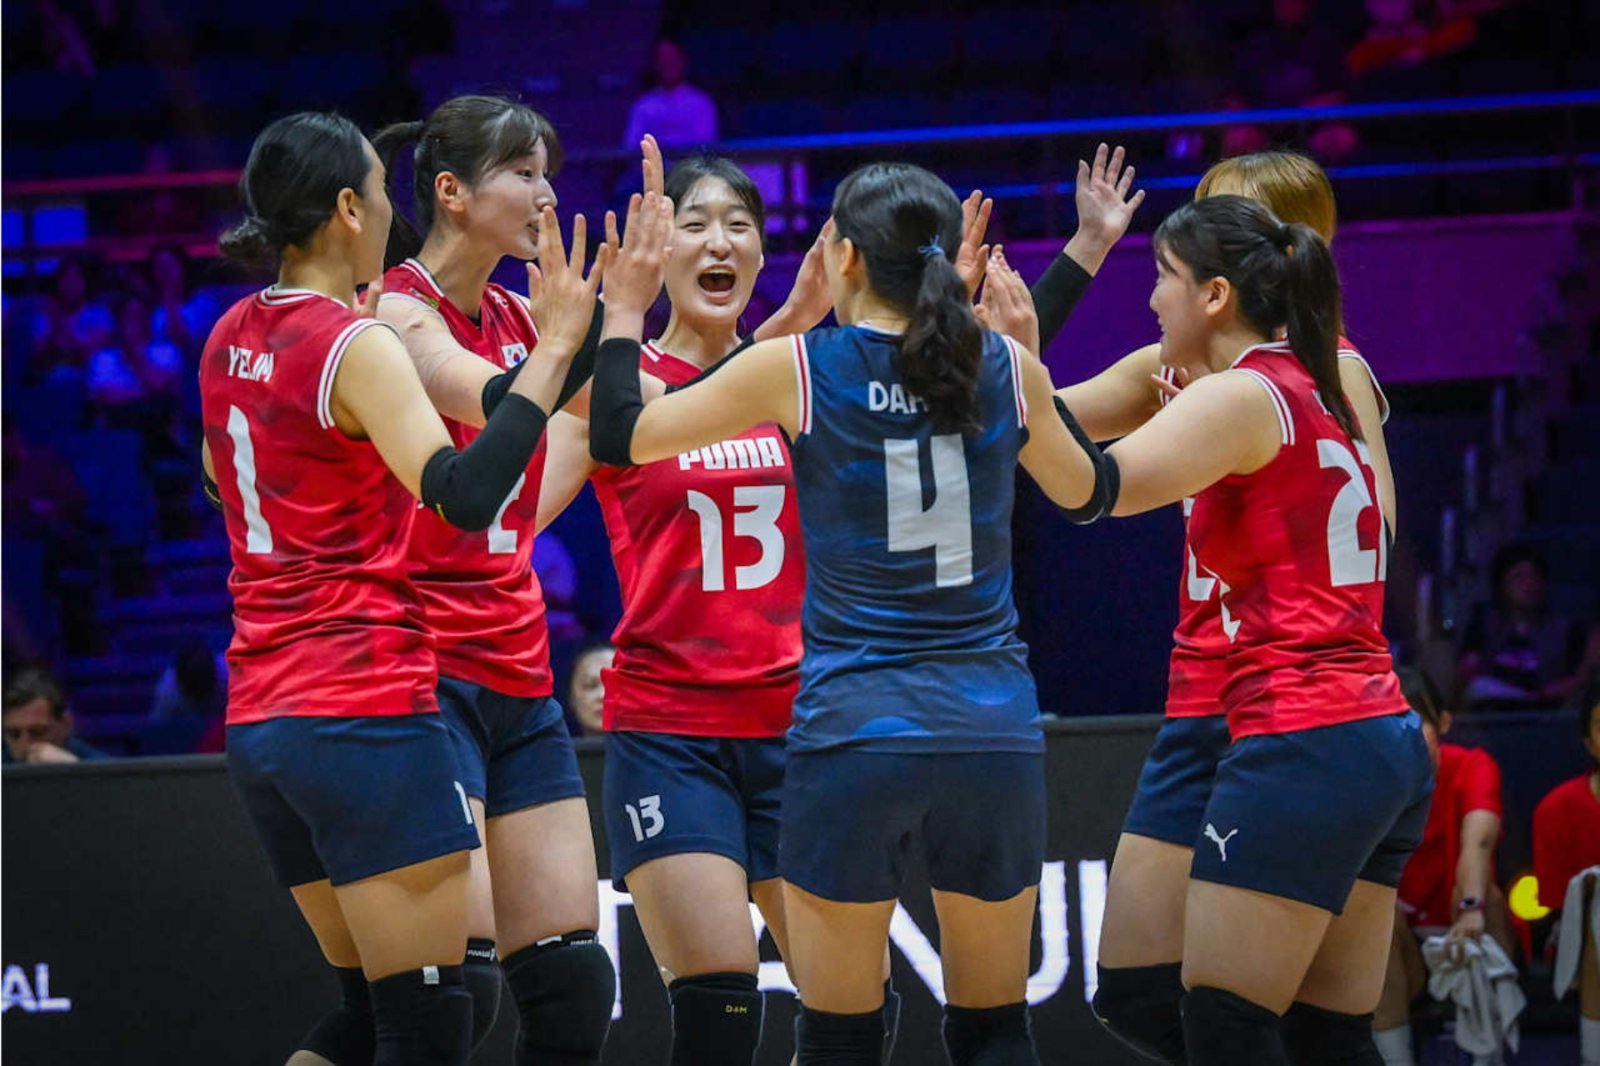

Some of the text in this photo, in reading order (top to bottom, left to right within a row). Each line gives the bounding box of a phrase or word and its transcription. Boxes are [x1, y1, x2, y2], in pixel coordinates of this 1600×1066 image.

[226, 404, 273, 554] 1
[678, 437, 785, 470] PUMA
[686, 485, 786, 592] 13
[884, 433, 973, 588] 4
[625, 794, 665, 842] 13
